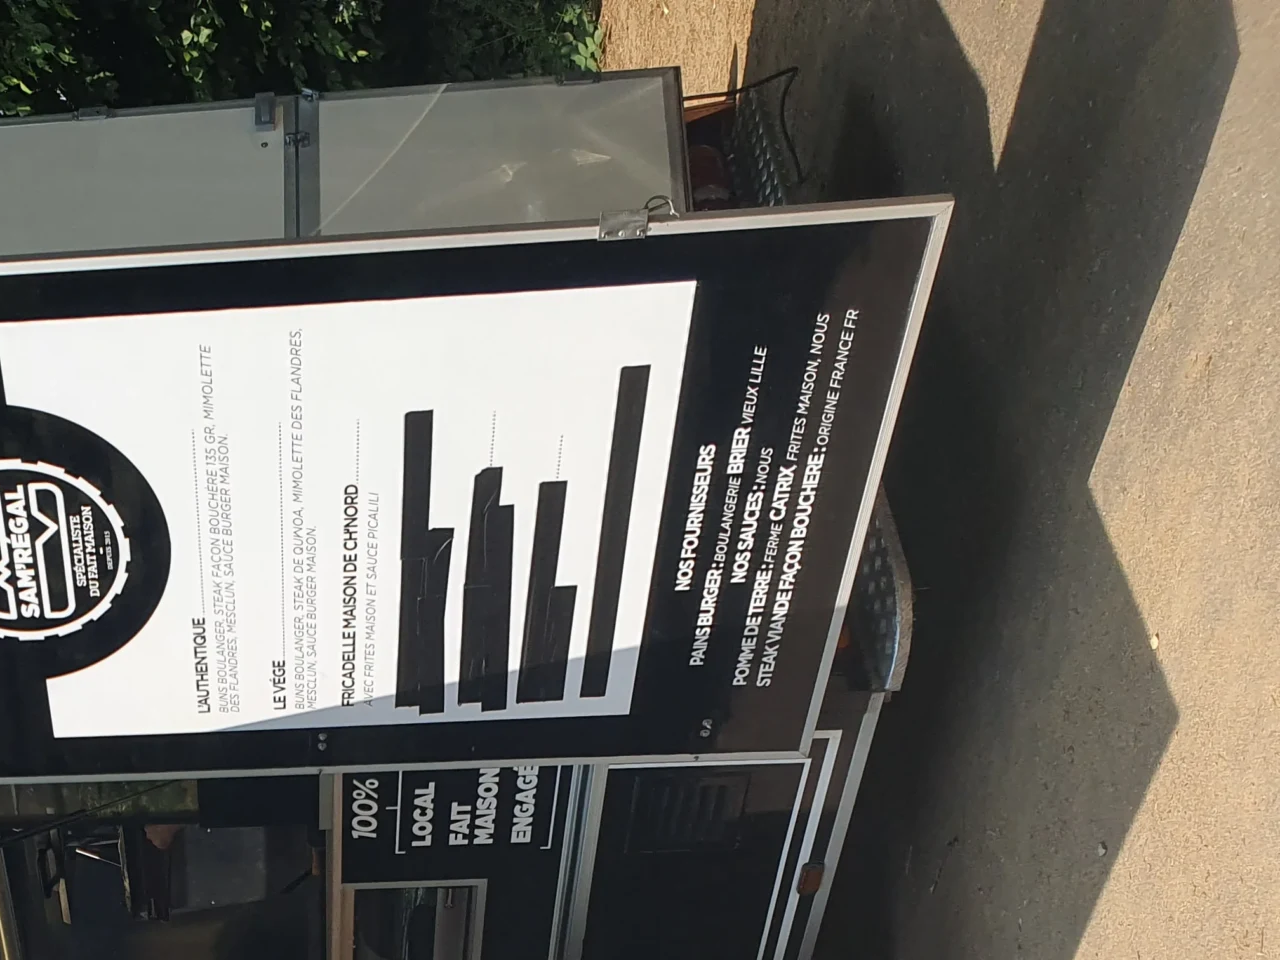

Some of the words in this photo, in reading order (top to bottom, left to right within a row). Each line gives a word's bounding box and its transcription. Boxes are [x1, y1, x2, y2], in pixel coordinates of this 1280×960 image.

[810, 312, 830, 354] NOUS
[843, 309, 860, 328] FR
[289, 328, 303, 401] FLANDRES,
[748, 345, 768, 384] LILLE
[829, 330, 854, 388] FRANCE
[199, 344, 214, 420] MIMOLETTE
[796, 358, 822, 414] MAISON,
[290, 405, 303, 430] DES
[741, 385, 760, 424] VIEUX
[816, 390, 840, 446] ORIGINE
[204, 424, 216, 444] GR,
[726, 427, 752, 474] BRIER
[786, 417, 806, 461] FRITES
[205, 448, 217, 466] 135
[217, 434, 230, 485] MAISON.
[291, 432, 303, 503] MIMOLETTE
[220, 488, 233, 536] BURGER
[343, 484, 358, 550] CH'NORD
[368, 492, 379, 539] PICALILI
[680, 444, 716, 558] FOURNISSEURS
[713, 476, 741, 562] BOULANGERIE
[730, 552, 751, 583] NOS
[756, 447, 774, 484] NOUS
[4, 484, 40, 618] SAM'RÉGAL
[69, 515, 87, 587] SPÉCIALISTE
[81, 506, 96, 553] MAISON
[306, 525, 317, 573] MAISON.
[764, 522, 784, 562] FERME
[86, 554, 98, 579] FAIT
[222, 540, 234, 577] SAUCE
[292, 558, 304, 574] DE
[343, 553, 358, 572] DE
[366, 542, 378, 580] SAUCE
[674, 560, 695, 591] NOS
[779, 540, 805, 589] FAÇON
[90, 581, 100, 597] DU
[212, 581, 224, 615] STEAK
[224, 580, 236, 633] MESCLUN,
[293, 576, 304, 611] STEAK
[306, 576, 317, 620] BURGER
[342, 576, 357, 628] MAISON
[366, 582, 376, 596] ET
[365, 598, 376, 640] MAISON
[744, 616, 762, 636] DE
[765, 590, 792, 644] VIANDE
[214, 620, 228, 684] BOULANGER,
[294, 614, 305, 680] BOULANGER,
[306, 622, 317, 657] SAUCE
[364, 643, 375, 678] FRITES
[688, 628, 711, 666] PAINS
[732, 637, 758, 686] POMME
[192, 617, 211, 714] L'AUTHENTIQUE
[226, 636, 239, 691] FLANDRES,
[269, 660, 286, 694] VÉGE
[306, 660, 318, 710] MESCLUN,
[341, 631, 356, 707] FRICADELLE
[756, 644, 780, 686] STEAK
[218, 687, 228, 713] BUNS
[229, 694, 240, 713] DES
[273, 696, 286, 710] LE
[294, 683, 305, 710] BUNS
[363, 679, 374, 707] AVEC
[351, 778, 379, 839] 100%
[412, 782, 435, 846] LOCAL
[448, 802, 471, 846] FAIT
[473, 768, 500, 844] MAISON
